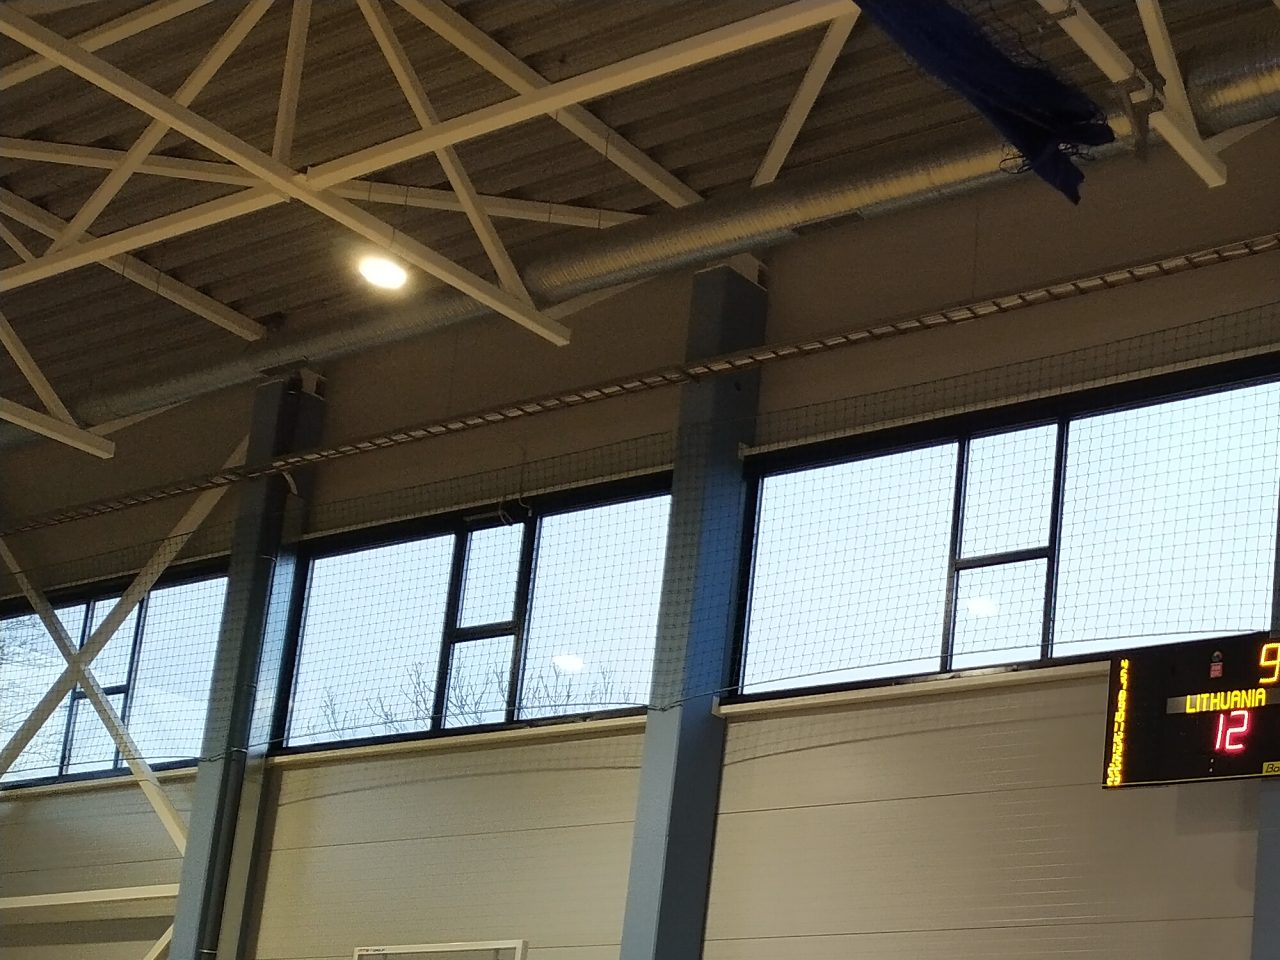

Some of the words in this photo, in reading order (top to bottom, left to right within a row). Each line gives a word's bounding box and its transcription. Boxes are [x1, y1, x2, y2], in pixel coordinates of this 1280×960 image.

[1185, 688, 1267, 714] LITHUANIA
[1114, 722, 1125, 732] 11
[1214, 710, 1249, 750] 12
